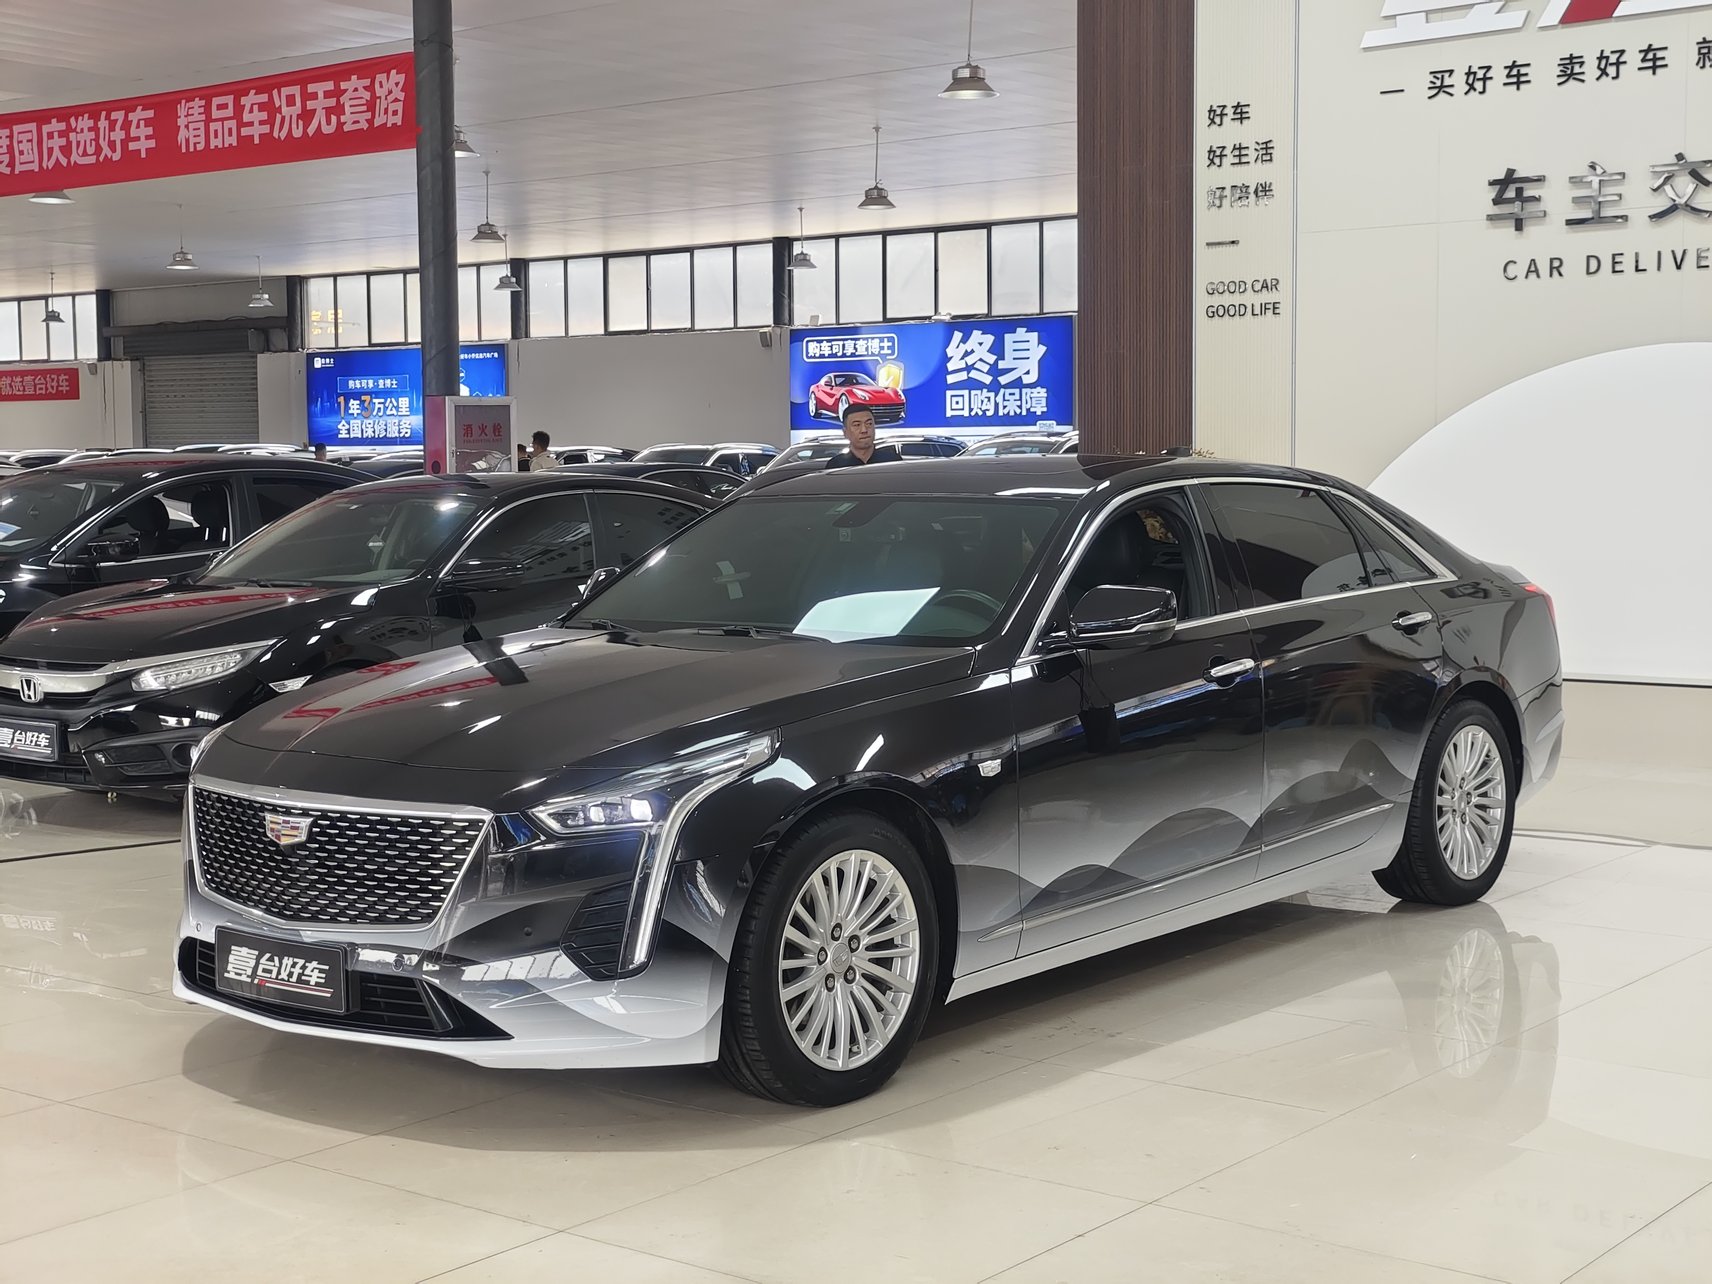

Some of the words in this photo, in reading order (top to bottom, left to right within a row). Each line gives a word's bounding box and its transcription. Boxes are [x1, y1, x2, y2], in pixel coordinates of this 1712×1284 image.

[1428, 60, 1531, 100] 买好车
[1557, 43, 1669, 86] 卖好车
[177, 68, 407, 153] 精品车况无套路
[1207, 101, 1251, 128] 好车
[1207, 139, 1275, 168] 好生活
[1207, 181, 1274, 209] 好陪伴
[1486, 152, 1712, 231] 车主交
[1503, 257, 1565, 281] CAR
[1585, 248, 1710, 276] DELIVE
[1206, 280, 1247, 295] GOOD
[1251, 278, 1280, 293] CAR
[1206, 303, 1247, 318] GOOD
[1251, 301, 1281, 316] LIFE
[807, 338, 893, 357] 购车可享查博士
[946, 327, 1048, 385] 终身
[1, 373, 70, 396] 就选壹台好车
[338, 396, 411, 418] 1年3万公里
[946, 387, 1048, 417] 回购保障
[338, 420, 412, 439] 全国保修服务
[224, 945, 330, 986] 壹台好车
